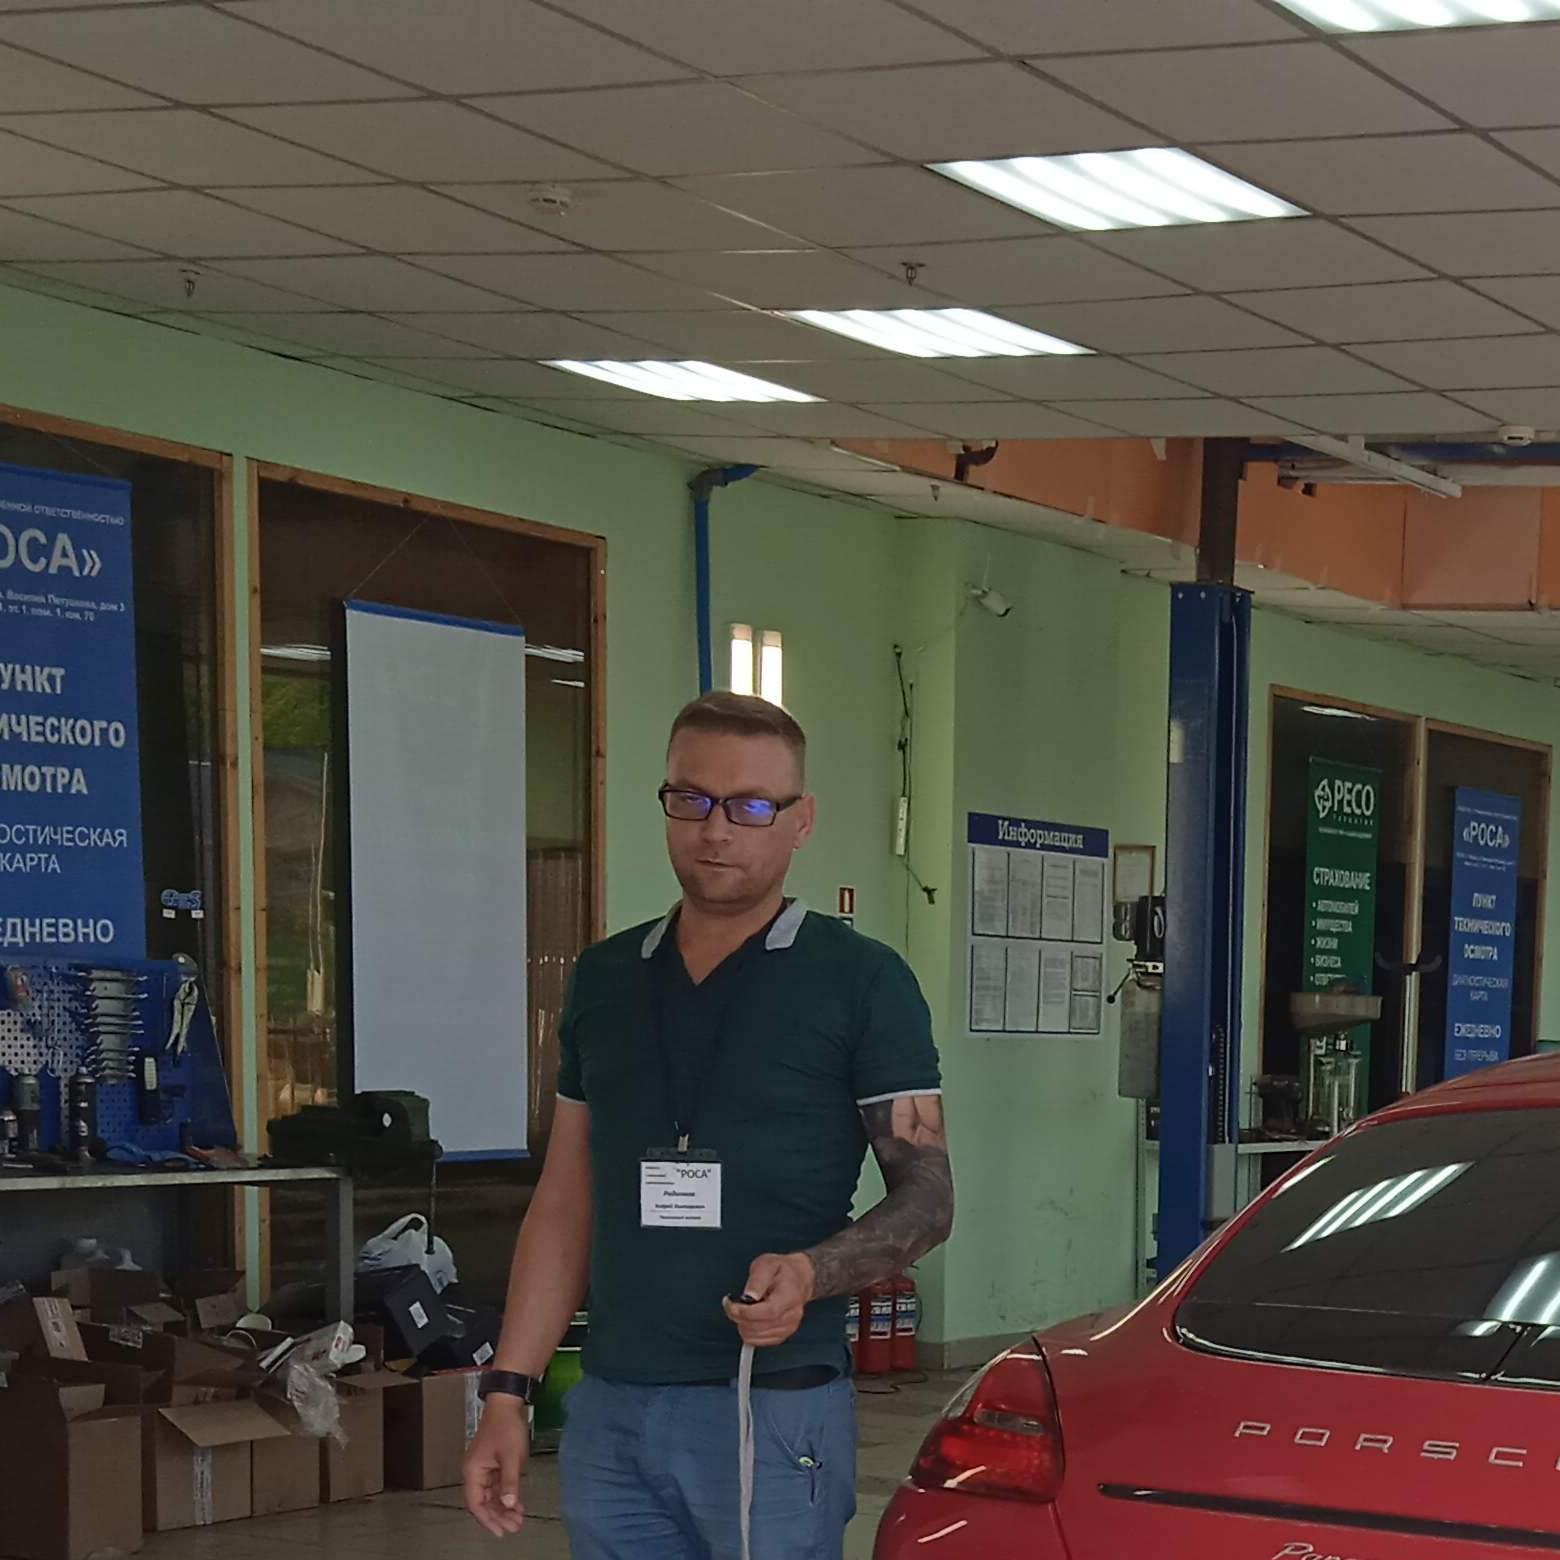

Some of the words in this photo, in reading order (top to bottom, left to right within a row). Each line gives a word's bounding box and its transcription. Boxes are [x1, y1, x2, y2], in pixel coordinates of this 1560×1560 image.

[0, 662, 65, 694] УНКТ
[1333, 779, 1375, 816] РЕСО
[998, 819, 1084, 849] Информация
[0, 917, 115, 947] ДНЕВНО
